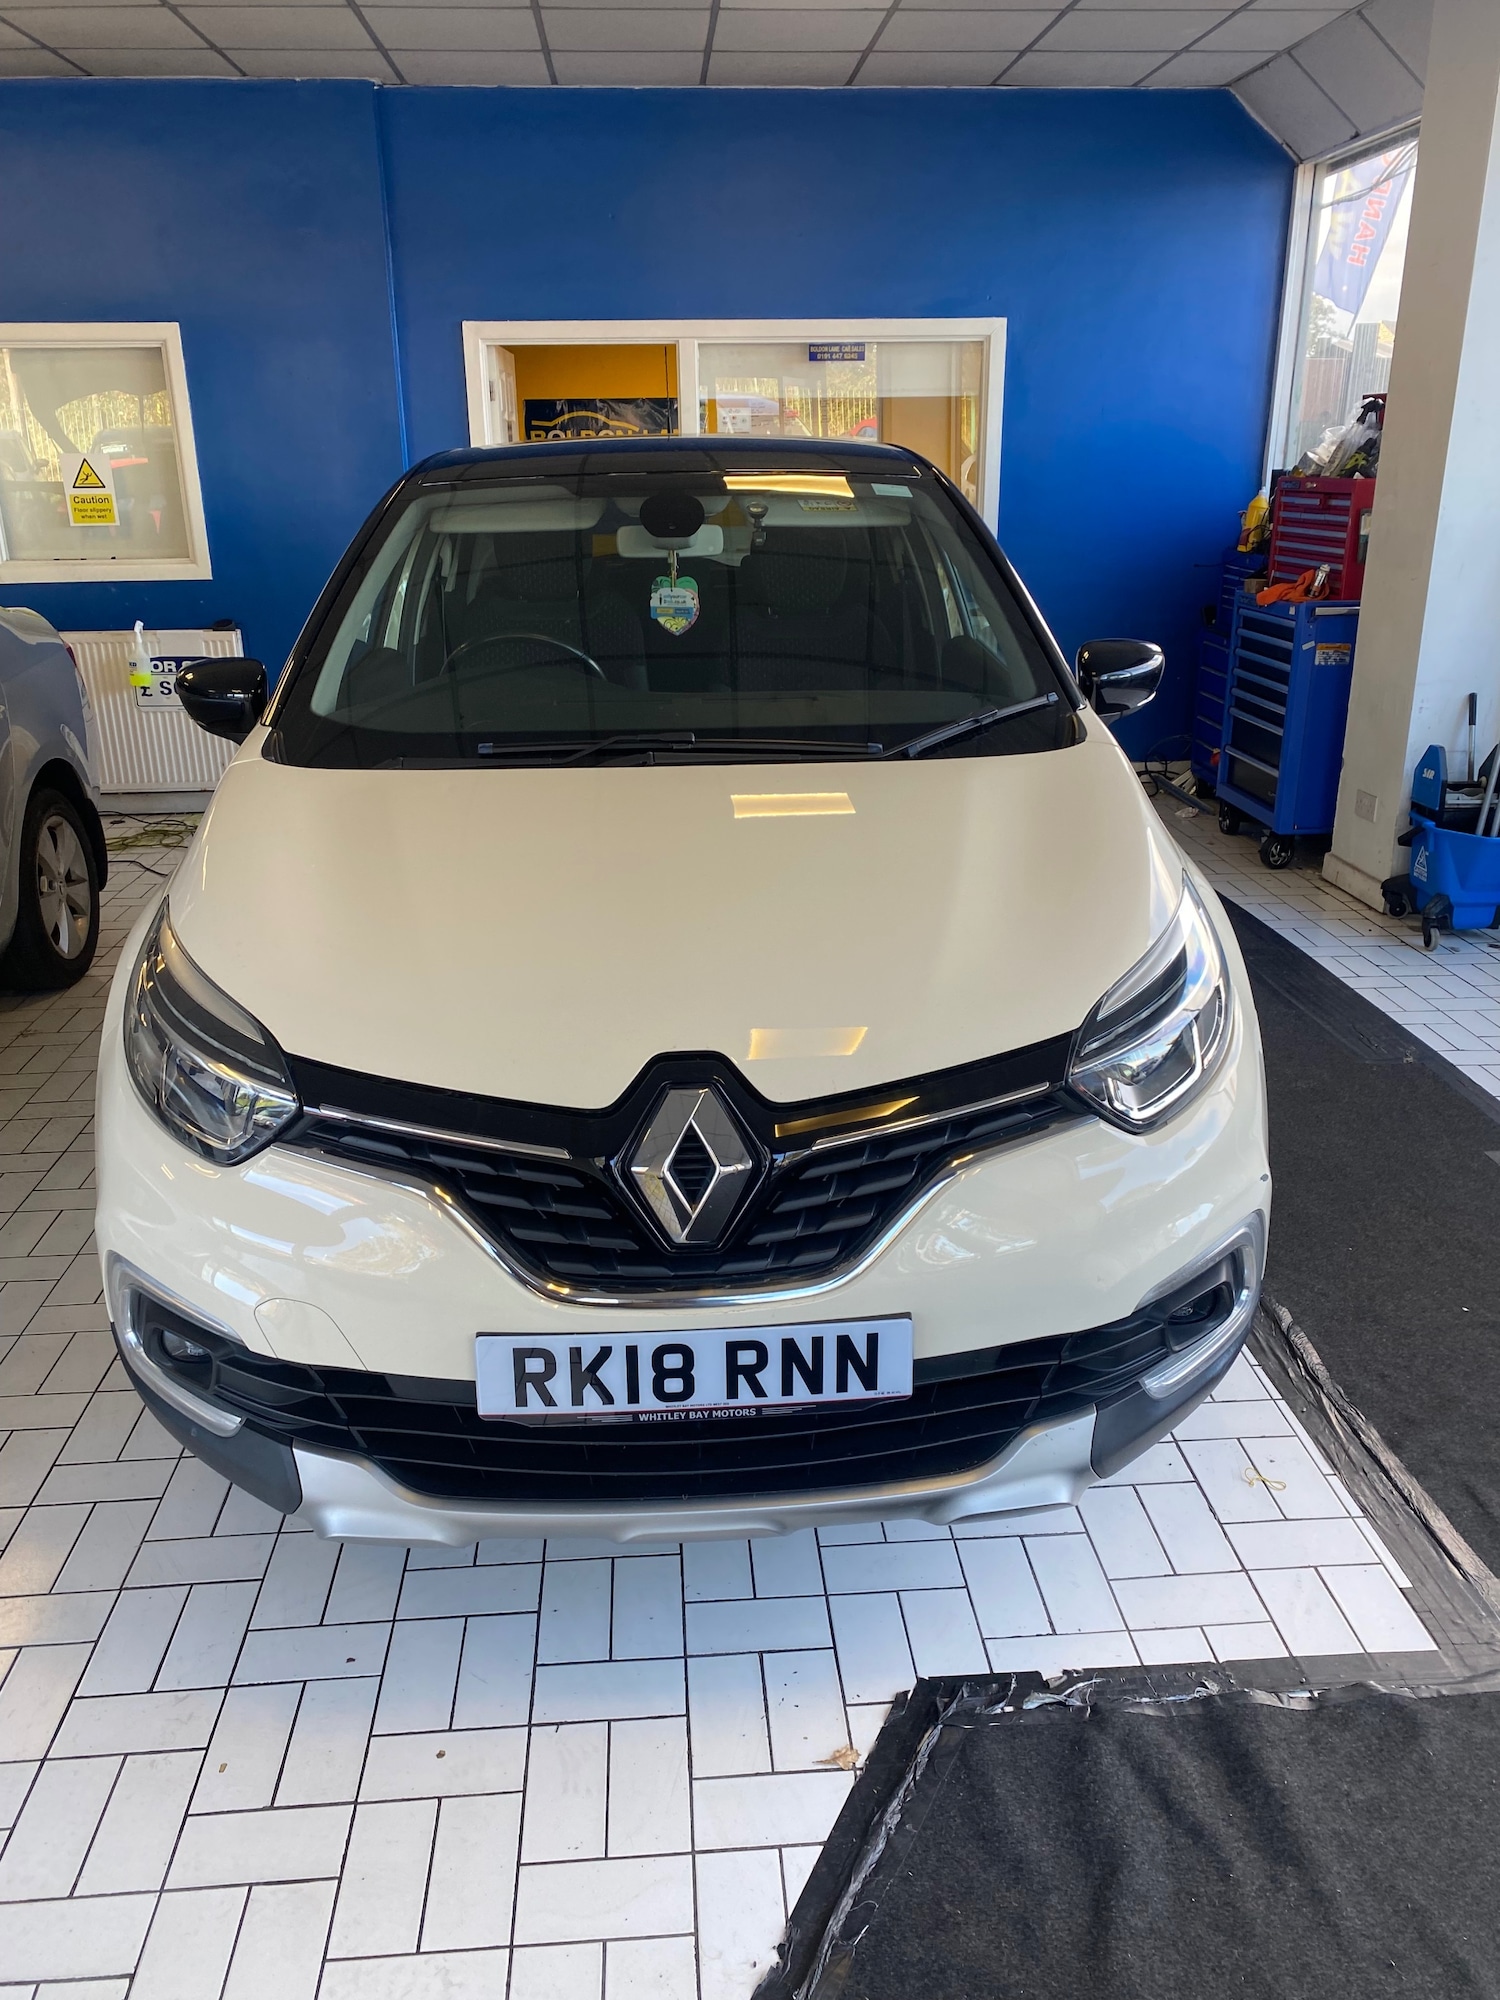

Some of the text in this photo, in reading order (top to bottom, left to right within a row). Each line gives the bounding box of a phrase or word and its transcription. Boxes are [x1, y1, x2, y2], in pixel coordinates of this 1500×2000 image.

[73, 496, 110, 504] Caution
[150, 660, 177, 673] OR
[512, 1332, 879, 1408] RK18 RNN
[638, 1407, 757, 1422] WHITLEY BAY MOTORS
